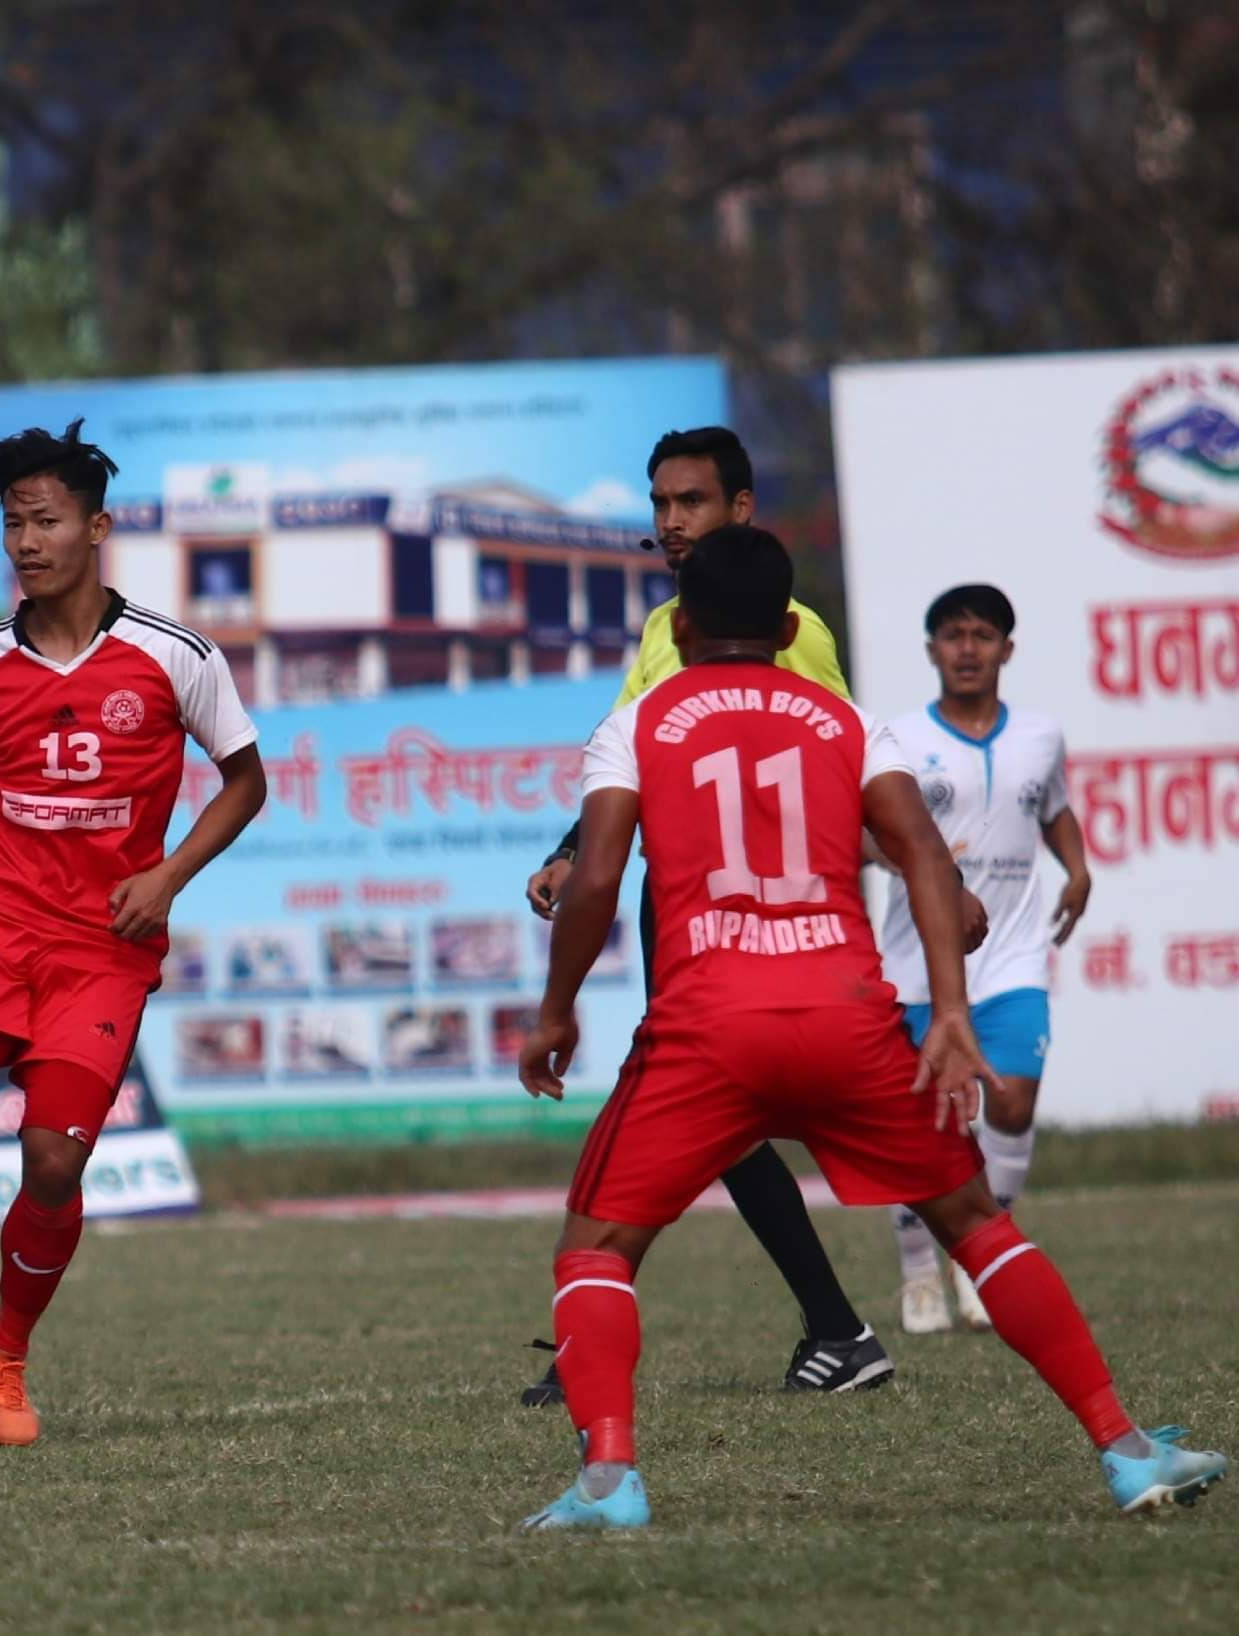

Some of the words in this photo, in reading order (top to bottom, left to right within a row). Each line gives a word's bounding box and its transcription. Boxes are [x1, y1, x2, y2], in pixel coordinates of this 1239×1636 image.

[654, 688, 764, 744] GURKHA
[769, 689, 844, 741] BOYS
[39, 732, 102, 781] 13
[692, 746, 828, 905] 11
[688, 910, 846, 956] RUPANDEHI
